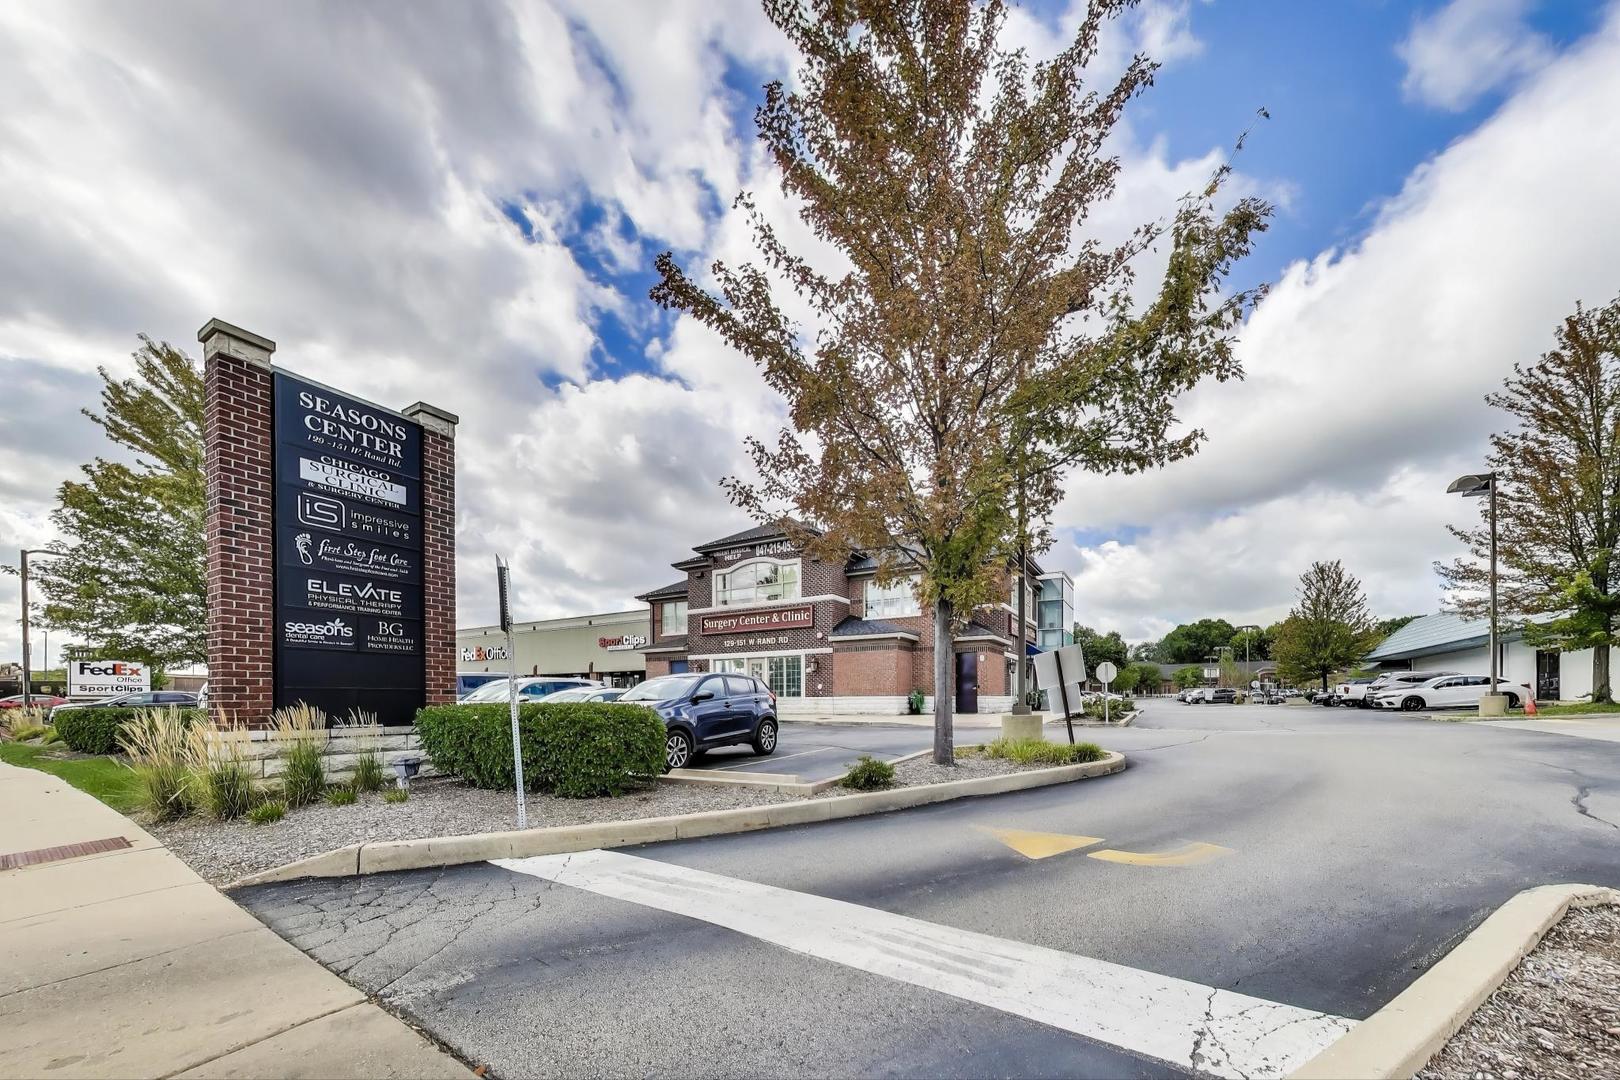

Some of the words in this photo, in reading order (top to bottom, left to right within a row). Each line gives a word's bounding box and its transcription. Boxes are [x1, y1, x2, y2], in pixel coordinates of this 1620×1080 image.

[299, 391, 407, 441] SEASONS
[304, 415, 404, 459] CENTER
[364, 450, 387, 462] Rand
[320, 455, 391, 481] CHICAGO
[309, 461, 399, 494] SURGICAL
[318, 483, 363, 500] SURGERY
[364, 495, 401, 509] CENTER
[324, 476, 387, 499] CLINIC
[350, 509, 410, 531] impressive
[351, 522, 410, 540] smiles
[390, 553, 409, 566] Care
[307, 579, 402, 603] ELEVATE
[307, 593, 358, 605] PHYSICAL
[360, 600, 402, 609] THERAPY
[313, 601, 356, 611] PERFORMANCE
[378, 621, 404, 636] BG
[703, 618, 738, 629] Surgery
[739, 615, 770, 626] Center
[771, 614, 780, 623] &
[782, 610, 810, 622] Clinic
[284, 621, 353, 637] seasons
[724, 638, 746, 647] 129-151
[748, 638, 755, 646] W
[757, 637, 776, 645] RAND
[460, 646, 486, 661] FedEx
[80, 663, 142, 676] FedEx
